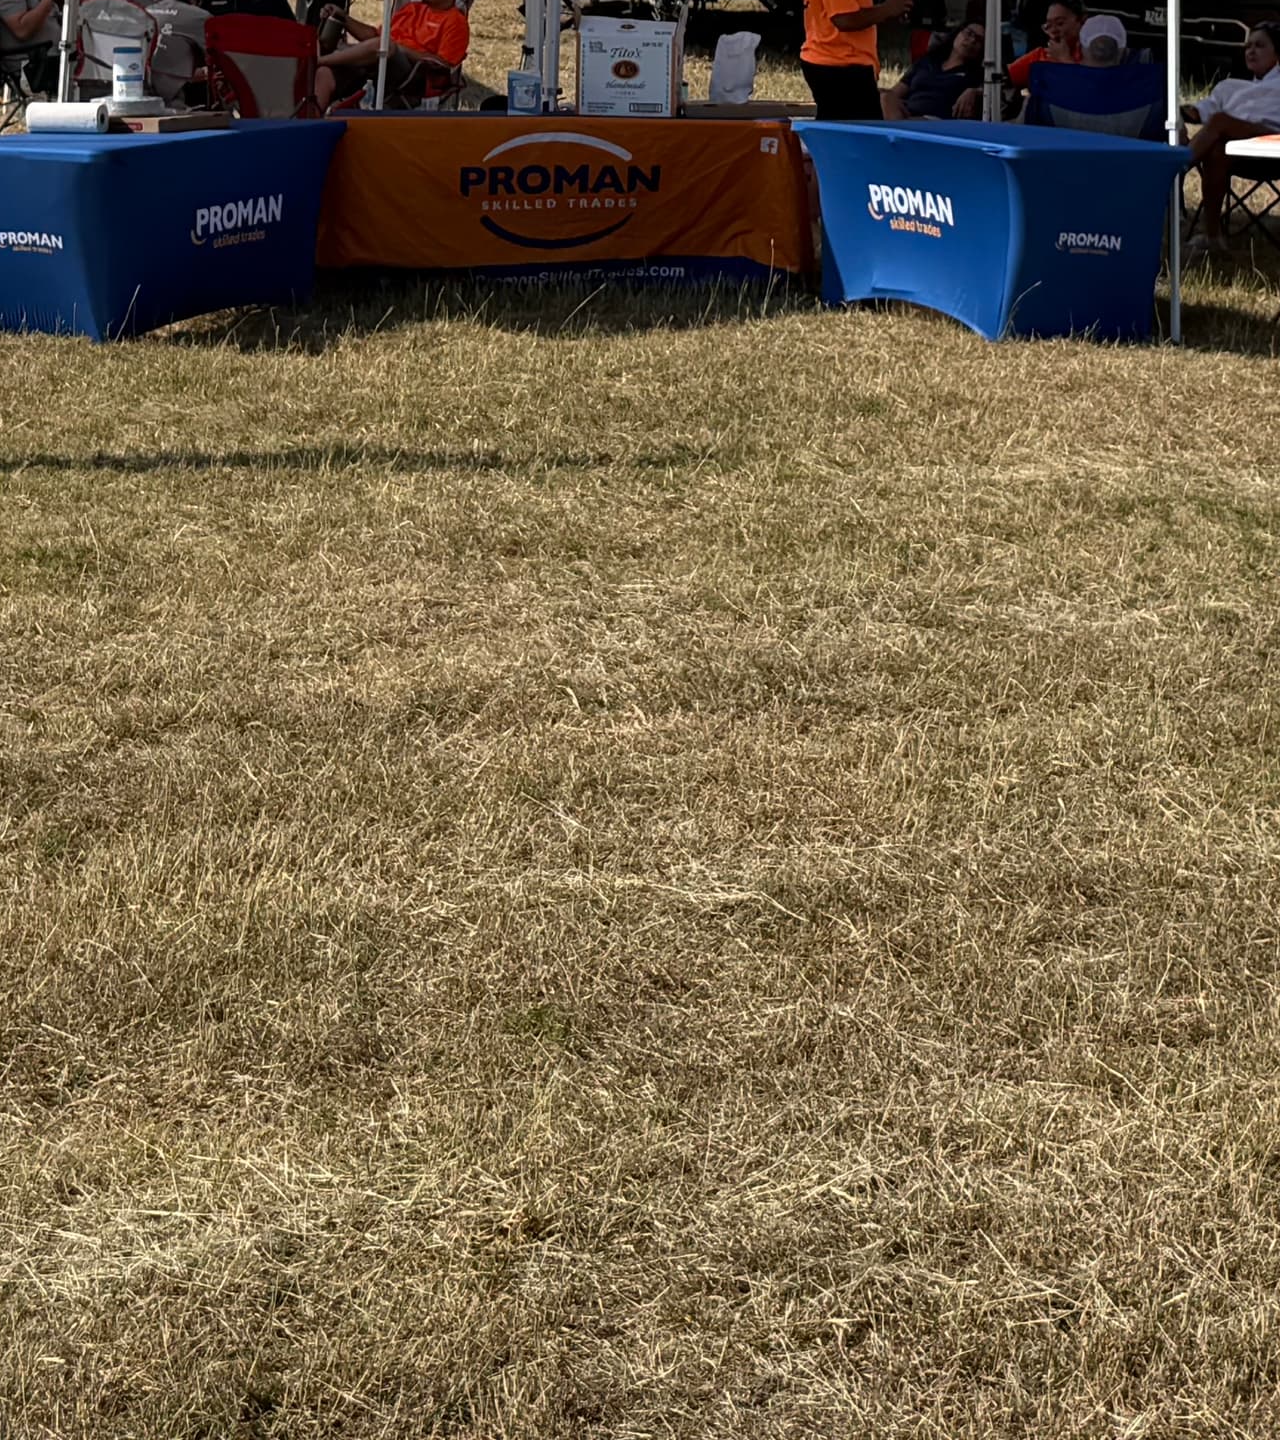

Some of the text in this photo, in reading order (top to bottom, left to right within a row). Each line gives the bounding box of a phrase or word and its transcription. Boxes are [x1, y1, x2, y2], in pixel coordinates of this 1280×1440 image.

[609, 47, 641, 58] Tito's
[460, 164, 661, 197] PROMAN
[480, 197, 638, 211] SKILLED TRADES
[868, 183, 954, 227] PROMAN
[196, 193, 283, 237] PROMAN
[0, 231, 64, 250] PROMAN
[1059, 232, 1122, 251] PROMAN
